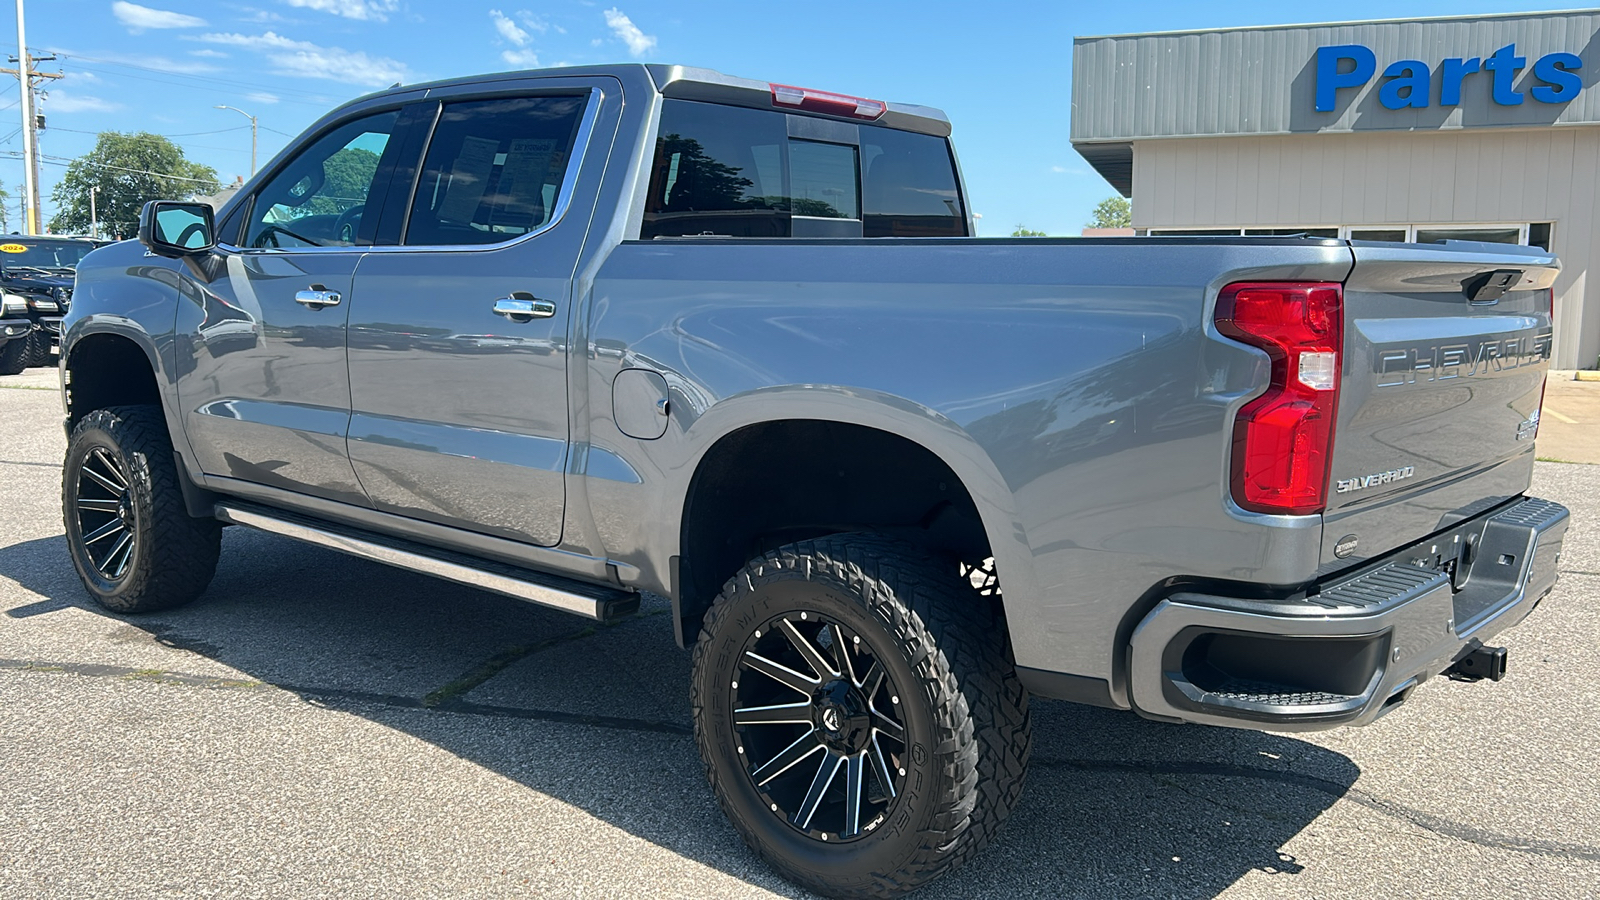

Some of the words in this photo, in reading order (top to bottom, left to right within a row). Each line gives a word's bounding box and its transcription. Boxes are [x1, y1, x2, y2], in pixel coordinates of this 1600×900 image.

[1315, 43, 1583, 112] Parts
[1336, 466, 1415, 494] SILVERADO
[736, 596, 771, 630] M/T
[885, 768, 923, 841] FUEL
[864, 814, 884, 832] FUEL
